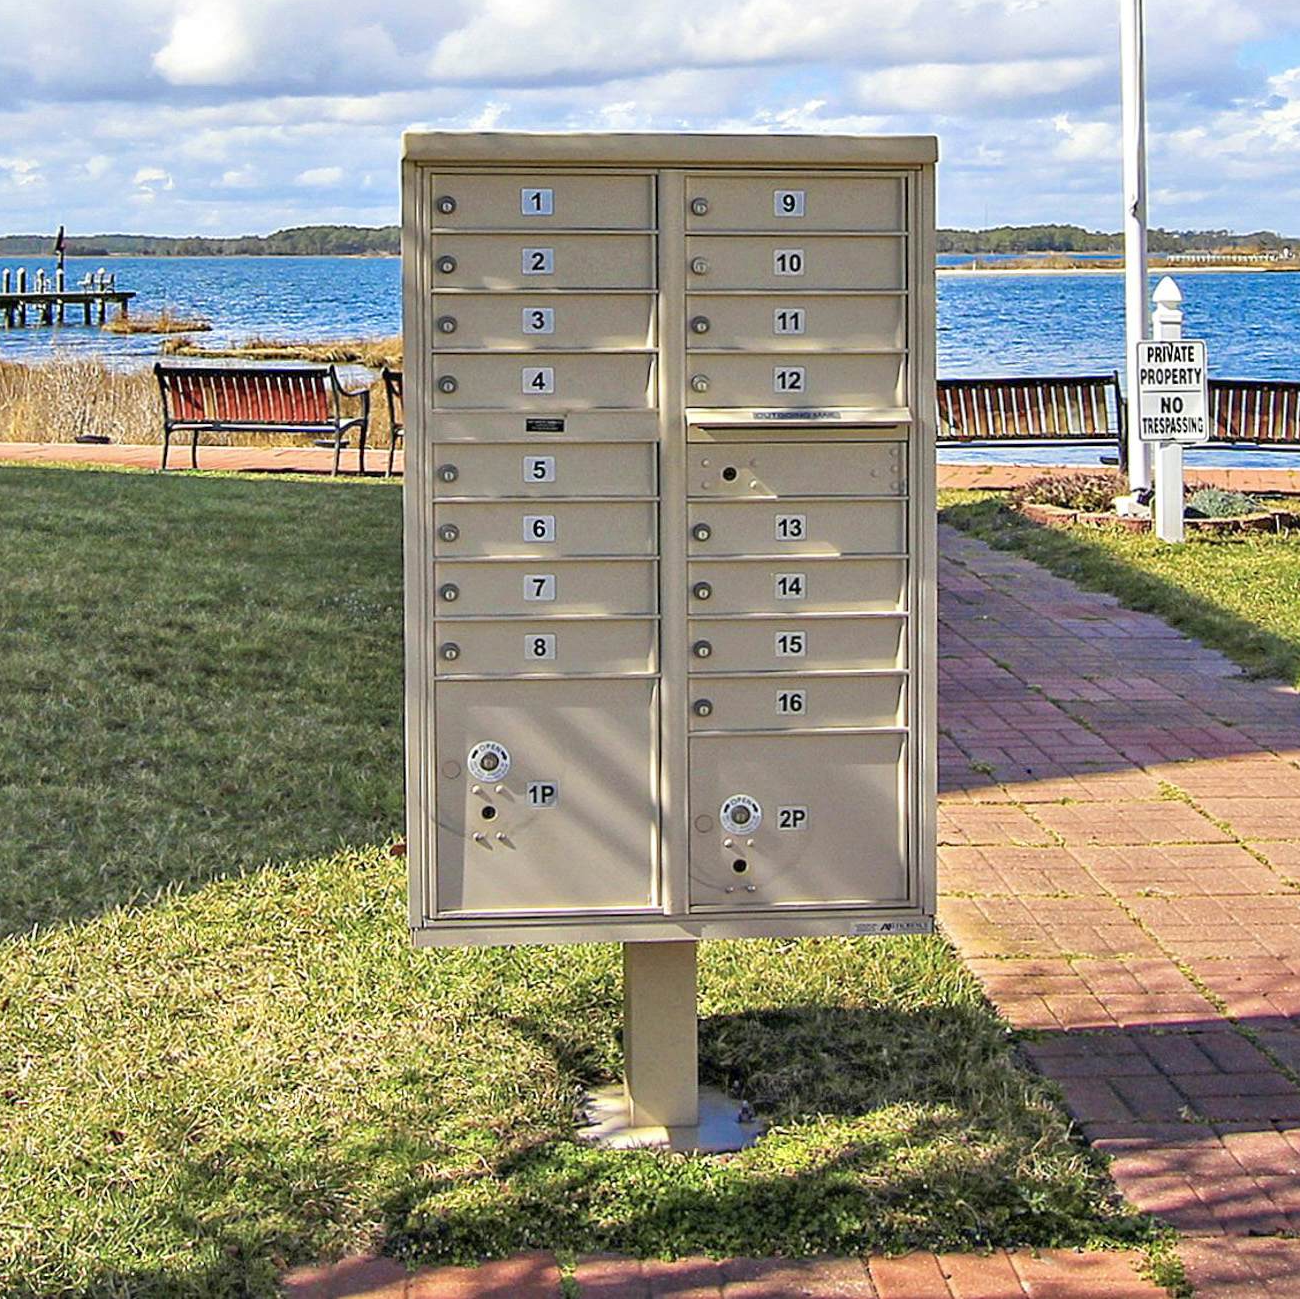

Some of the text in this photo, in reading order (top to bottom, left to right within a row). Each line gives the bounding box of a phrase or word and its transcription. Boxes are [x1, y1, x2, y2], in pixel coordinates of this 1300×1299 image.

[532, 193, 541, 210] 1
[783, 195, 795, 213] 9
[532, 252, 545, 270] 2
[777, 254, 801, 272] 10
[532, 311, 544, 329] 3
[777, 312, 799, 330] 11
[1147, 346, 1195, 363] PRIVATE
[532, 372, 545, 390] 4
[777, 371, 801, 389] 12
[1140, 367, 1202, 385] PROPERTY
[1160, 397, 1184, 414] NO
[1142, 417, 1204, 434] TRESPASSING
[533, 461, 546, 478] 5
[533, 520, 545, 537] 6
[779, 519, 802, 536] 13
[533, 579, 545, 596] 7
[778, 578, 802, 595] 14
[534, 639, 546, 656] 8
[779, 636, 802, 653] 15
[779, 694, 802, 712] 16
[479, 743, 501, 753] OPEN
[529, 786, 554, 803] 1P
[730, 797, 752, 806] OPEN
[780, 810, 805, 828] 2P
